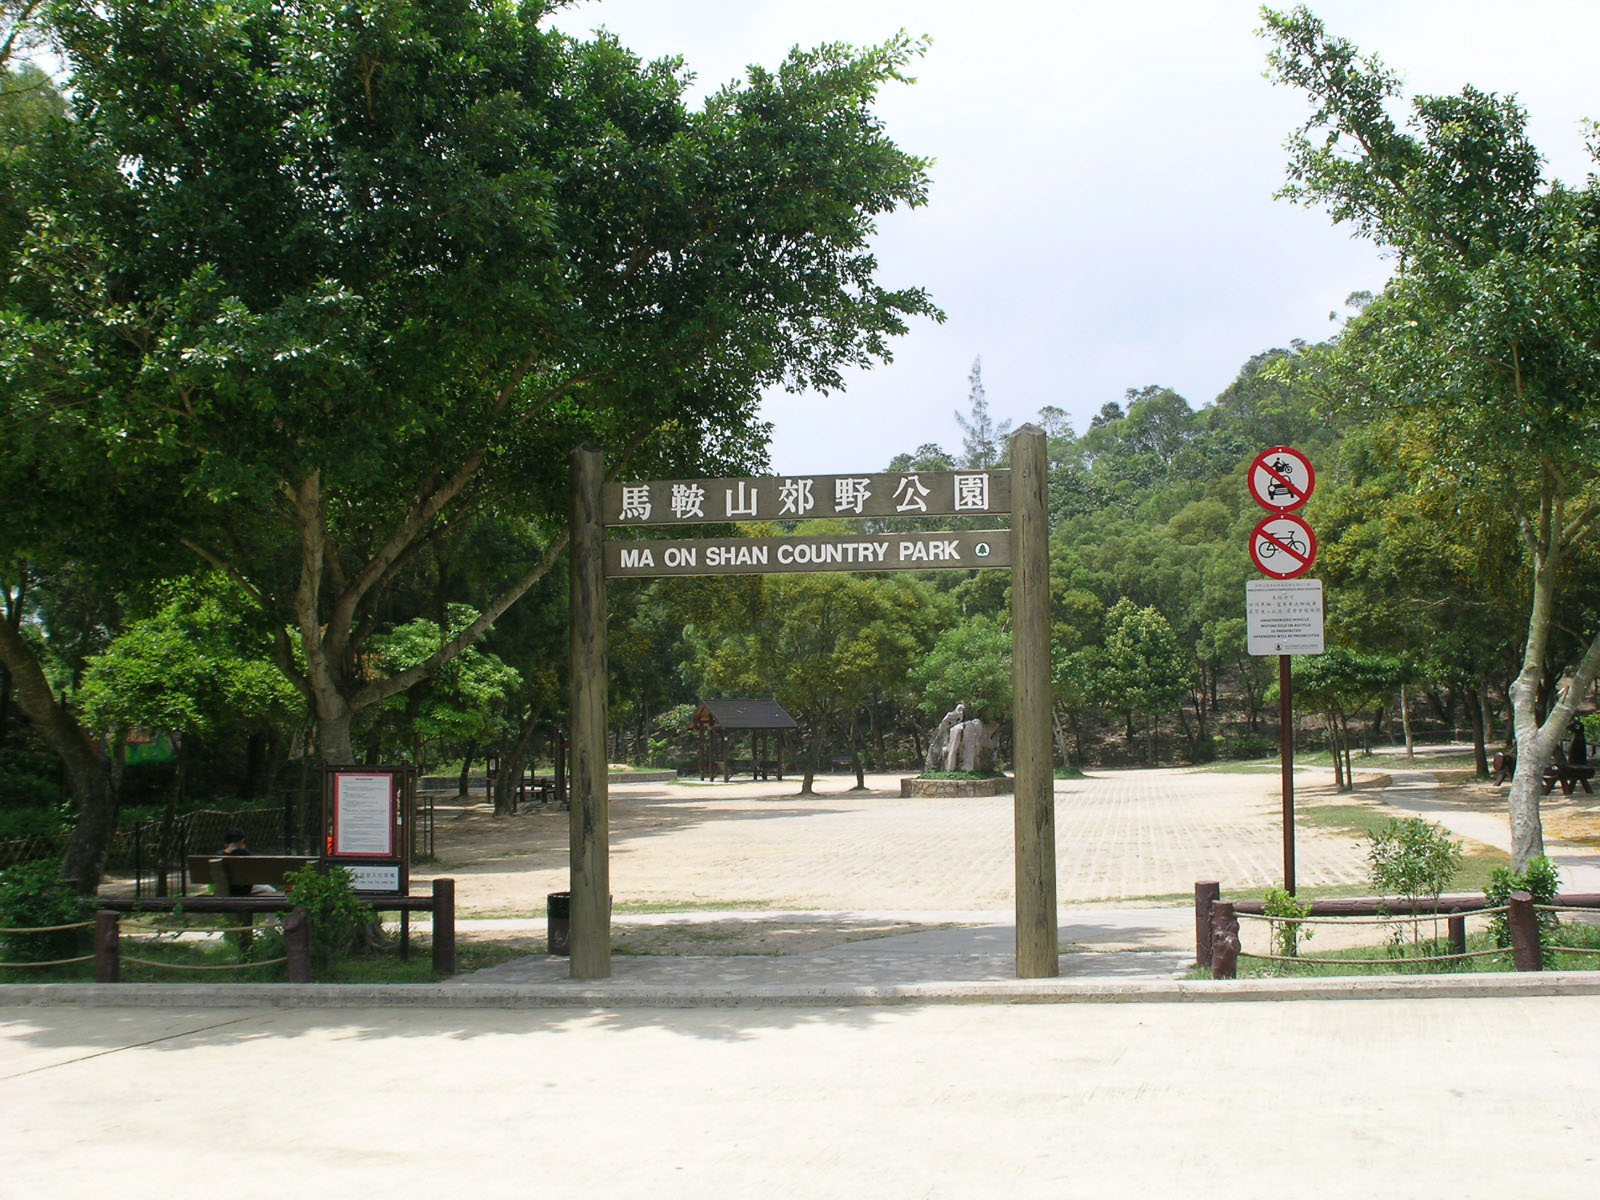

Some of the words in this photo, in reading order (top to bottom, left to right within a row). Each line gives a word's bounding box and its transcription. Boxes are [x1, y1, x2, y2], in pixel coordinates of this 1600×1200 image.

[619, 473, 990, 521] 馬鞍山郊野公園
[620, 549, 655, 568] MA
[664, 547, 697, 567] ON
[706, 545, 769, 566] SHAN
[777, 541, 889, 564] COUNTRY
[899, 540, 961, 561] PARK
